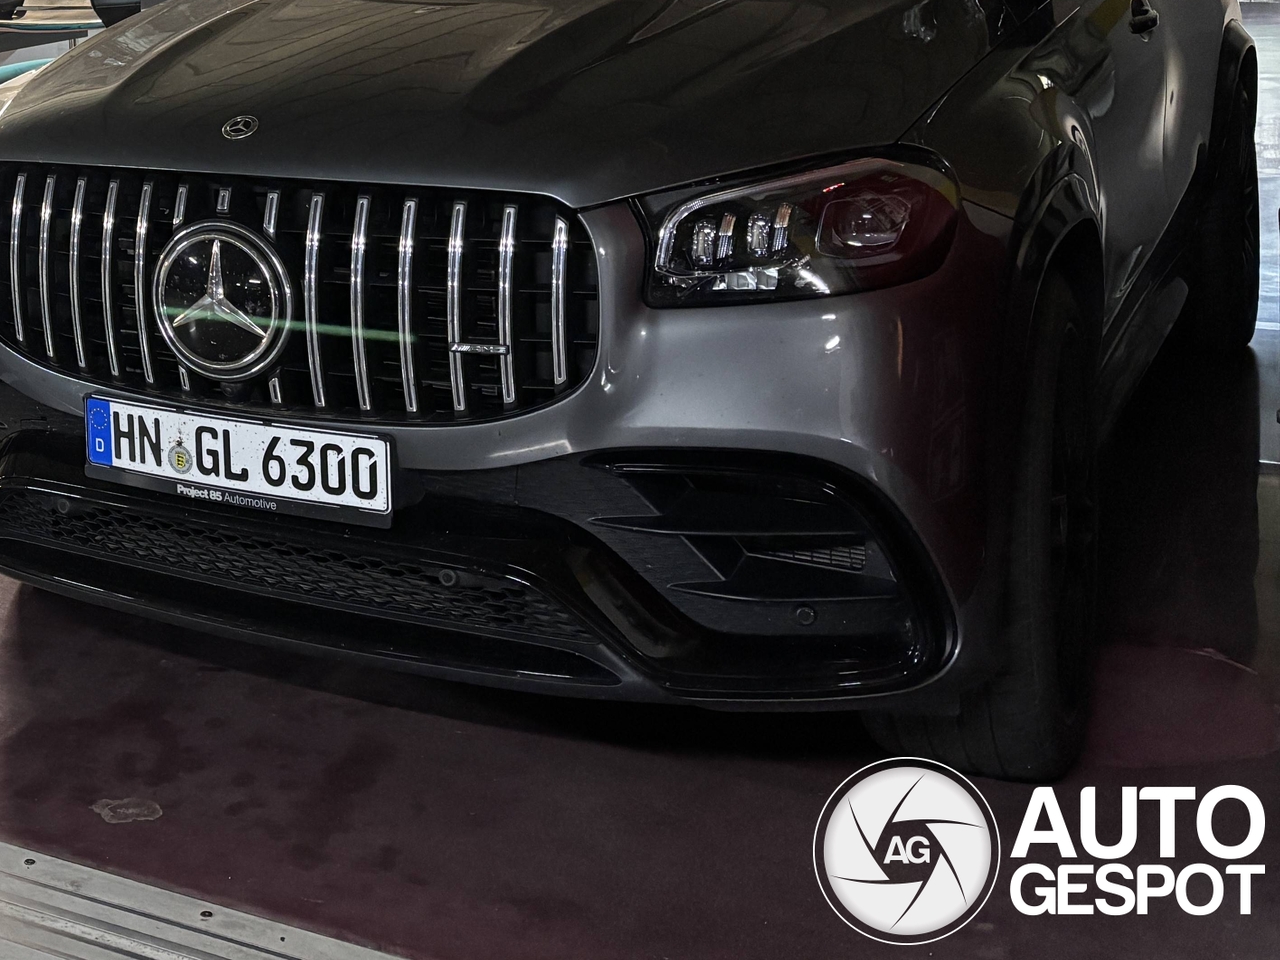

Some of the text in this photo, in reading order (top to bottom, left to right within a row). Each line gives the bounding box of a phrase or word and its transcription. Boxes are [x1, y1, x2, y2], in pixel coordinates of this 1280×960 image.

[95, 437, 105, 452] D
[112, 410, 377, 500] HN GL 6300
[176, 483, 277, 511] Project 85 Automotive
